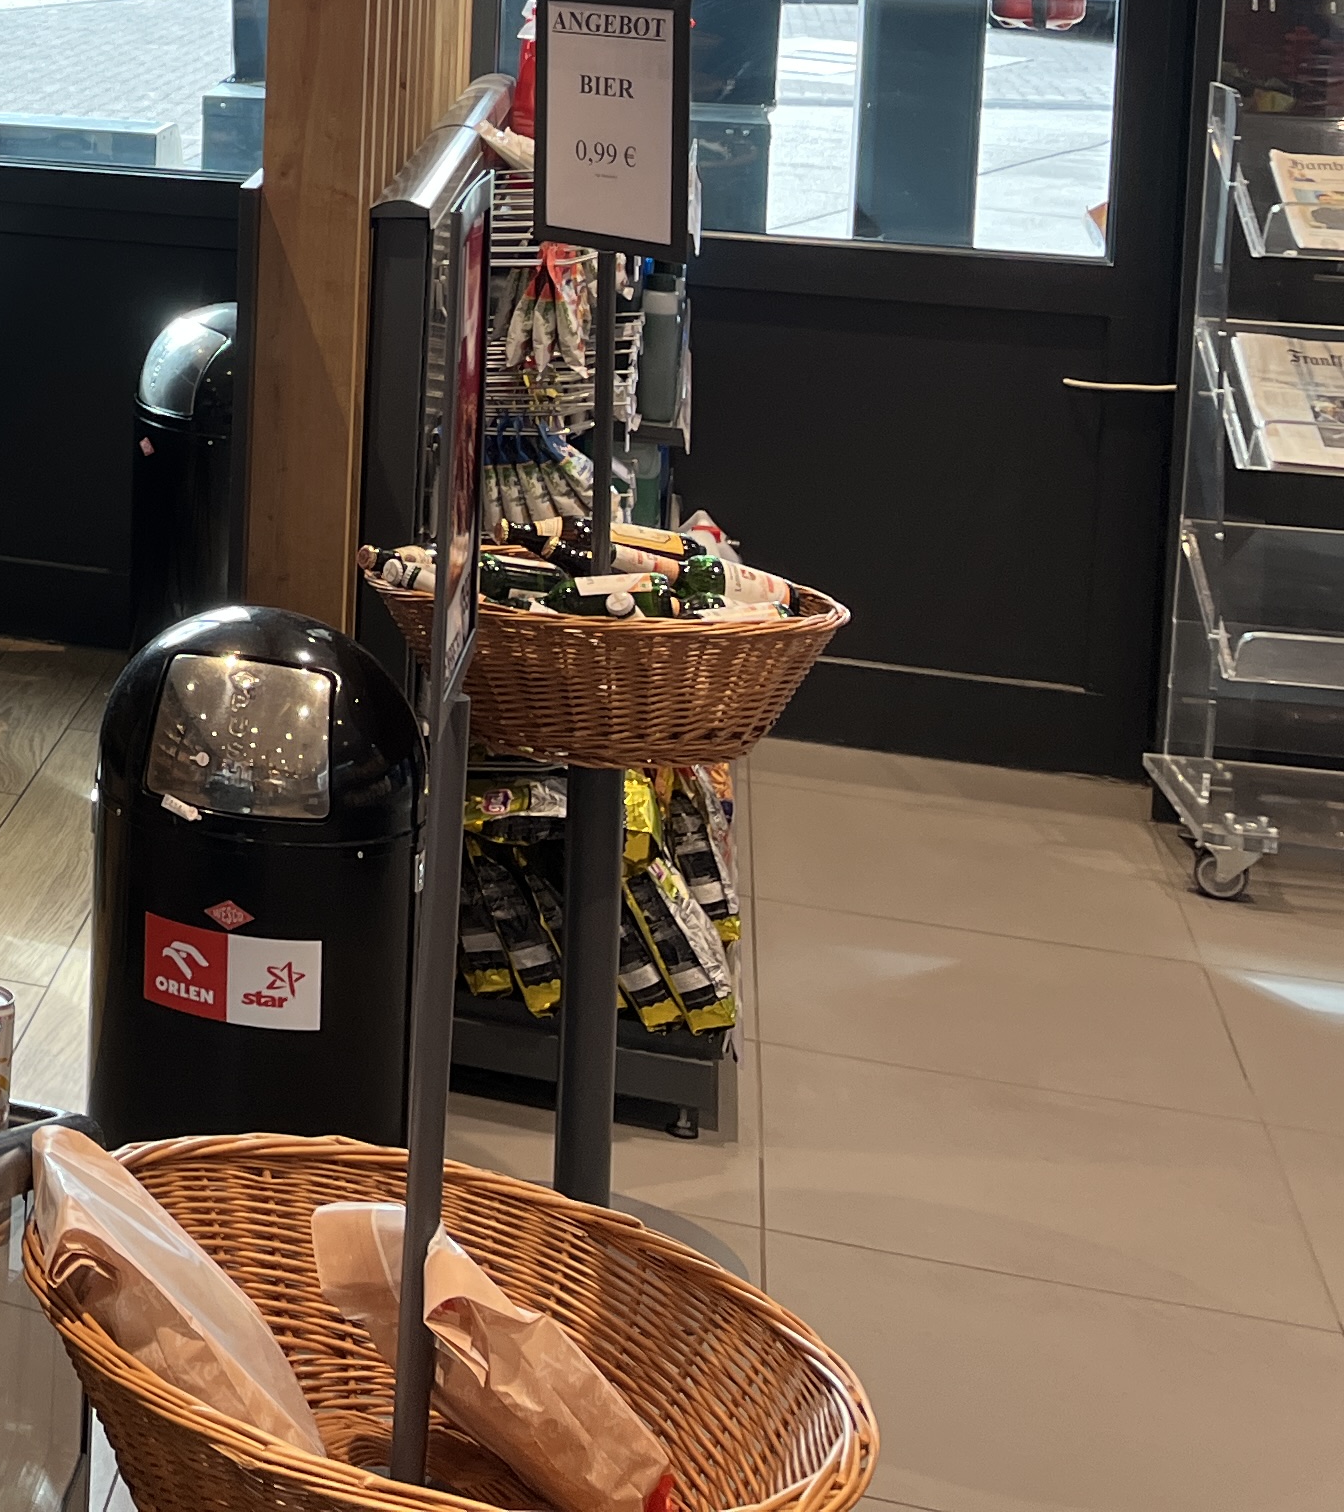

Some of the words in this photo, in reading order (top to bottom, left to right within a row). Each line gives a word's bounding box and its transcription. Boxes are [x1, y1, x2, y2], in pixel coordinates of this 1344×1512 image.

[553, 11, 666, 38] ANGEBOT
[579, 74, 634, 99] BIER
[575, 139, 618, 166] 0,99
[624, 146, 637, 168] €
[154, 975, 214, 1005] ORLEN
[241, 989, 290, 1009] star
